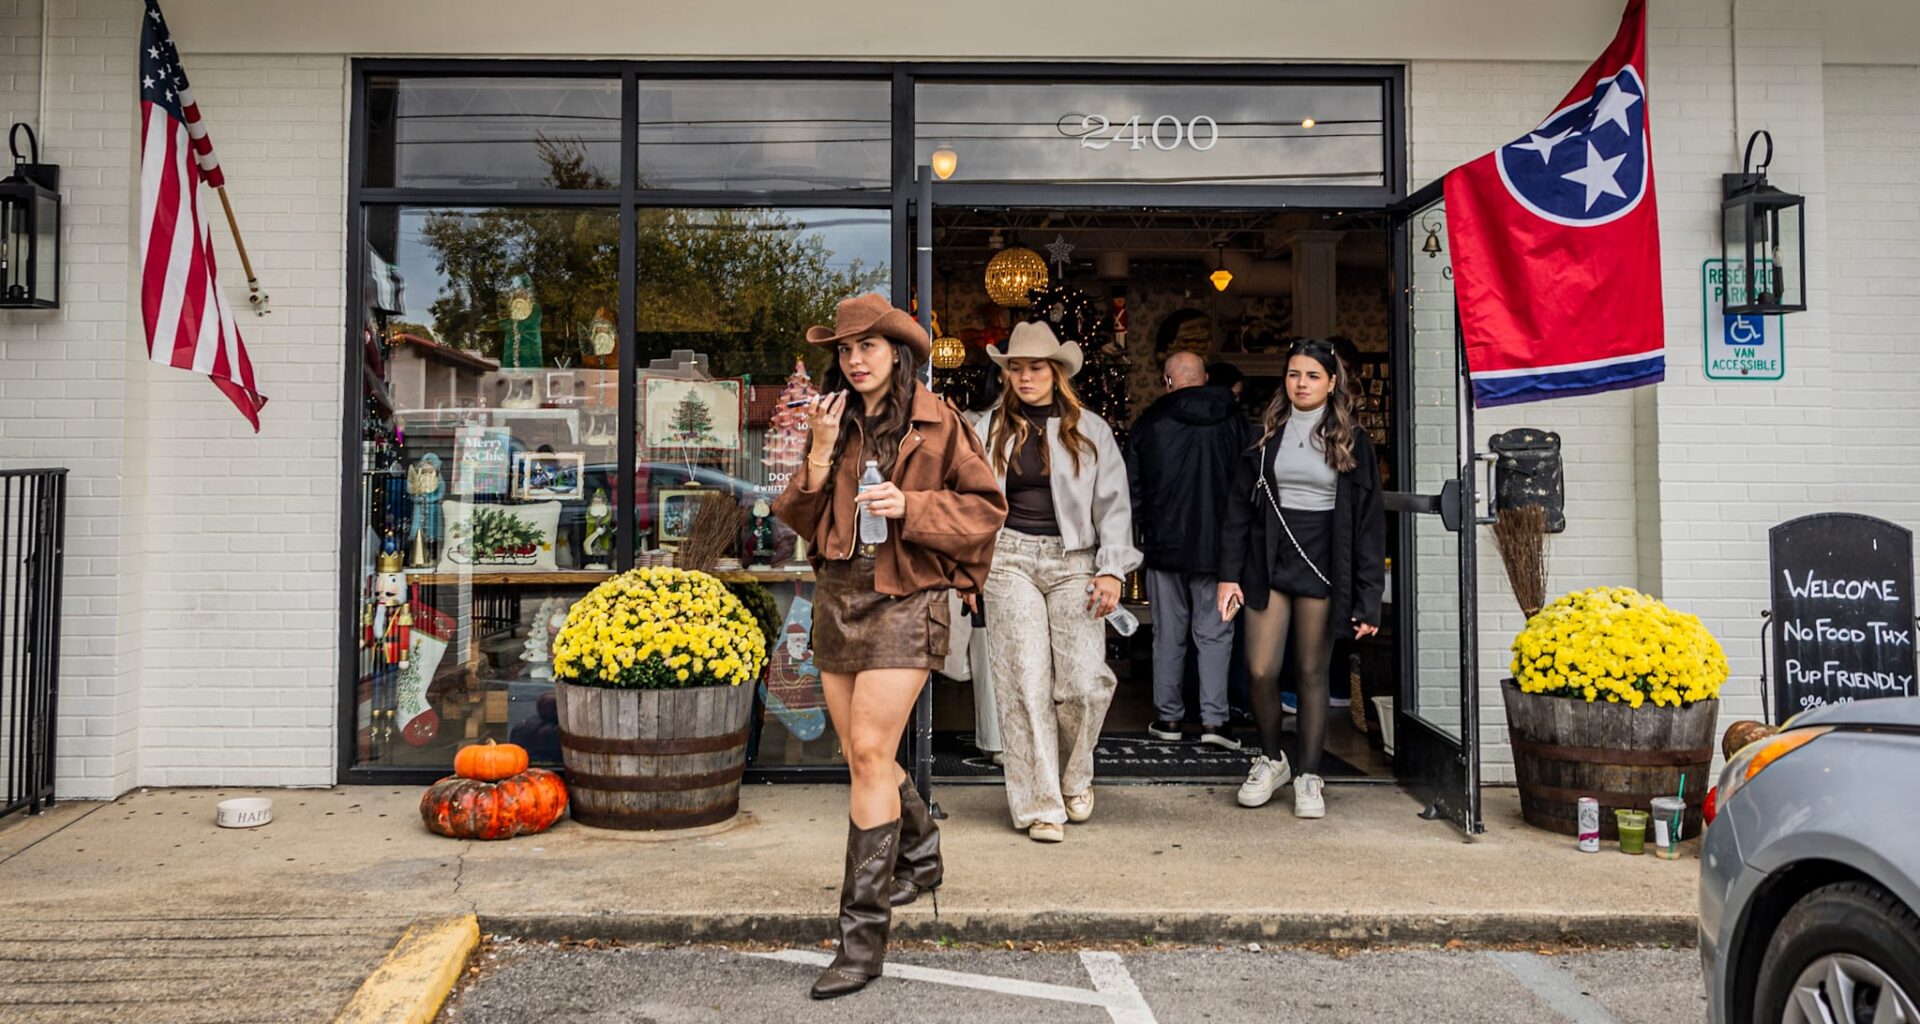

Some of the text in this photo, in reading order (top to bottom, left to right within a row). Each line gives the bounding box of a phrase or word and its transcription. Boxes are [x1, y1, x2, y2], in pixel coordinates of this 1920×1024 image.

[1080, 113, 1219, 151] 2400
[1712, 359, 1777, 371] ACCESSIBLE
[1733, 347, 1755, 358] VAN
[464, 437, 501, 450] Merry
[1783, 568, 1900, 601] WELCOME
[1815, 618, 1866, 642] FOOD
[1867, 621, 1911, 646] THX
[1823, 660, 1912, 698] FRIENDLY
